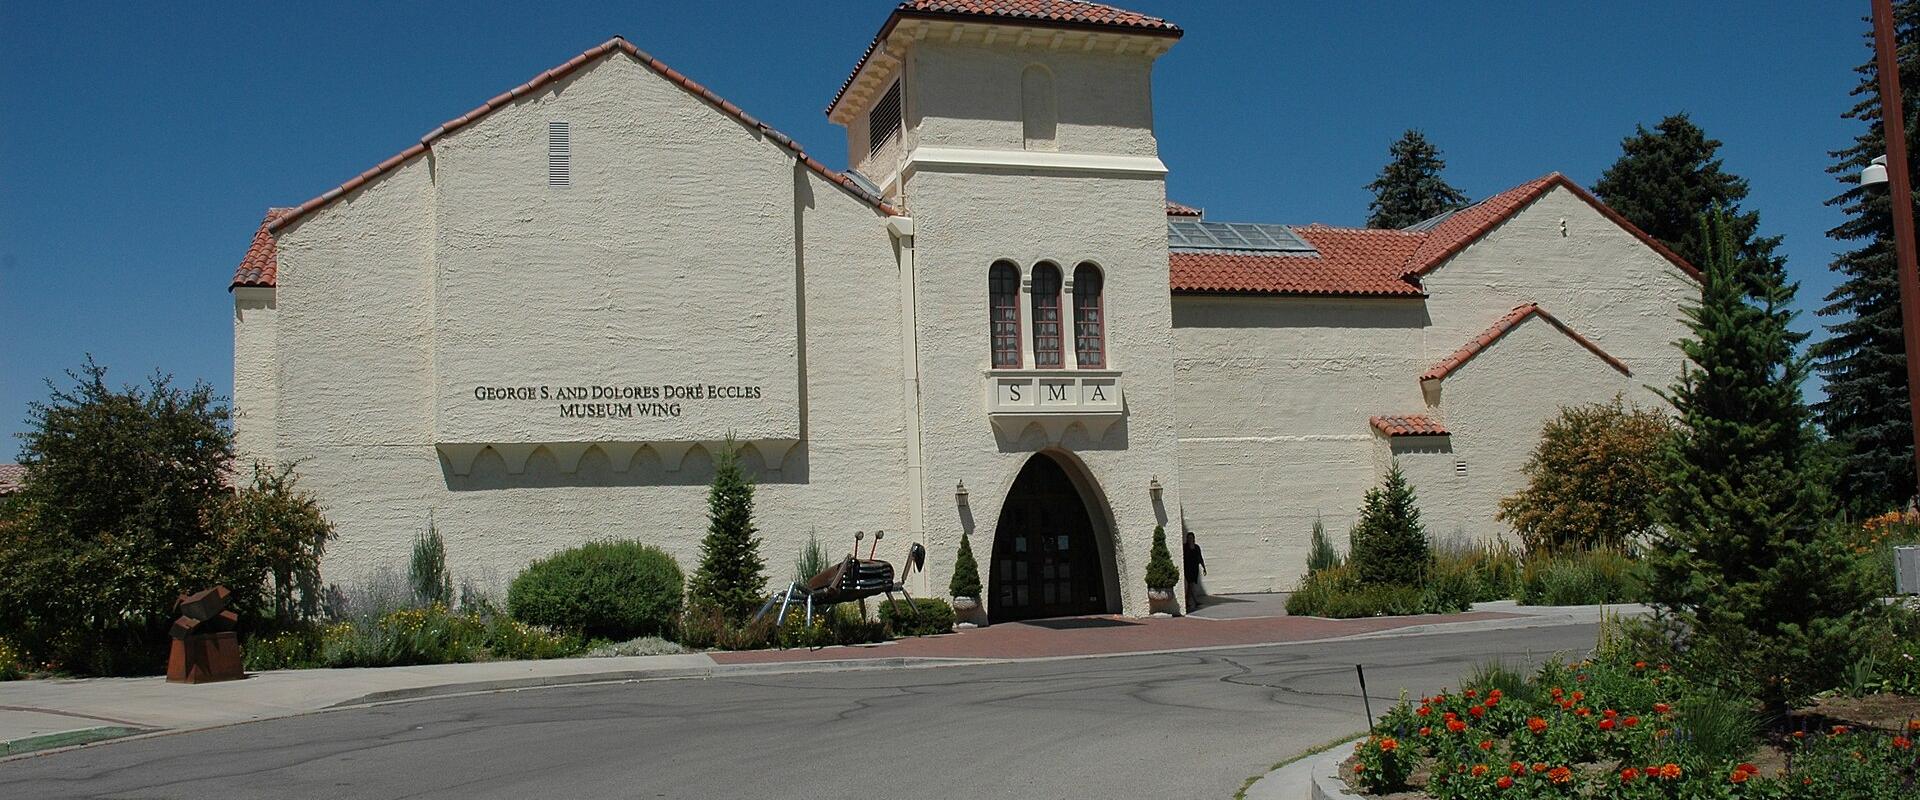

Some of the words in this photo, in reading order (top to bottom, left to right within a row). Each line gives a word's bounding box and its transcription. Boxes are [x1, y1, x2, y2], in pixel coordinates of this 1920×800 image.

[474, 386, 536, 400] GEORGE
[540, 386, 552, 400] S.
[556, 387, 588, 400] AND
[591, 385, 660, 399] DOLORES
[706, 385, 761, 399] ECCLES
[559, 404, 632, 418] MUSEUM
[637, 403, 681, 417] WING
